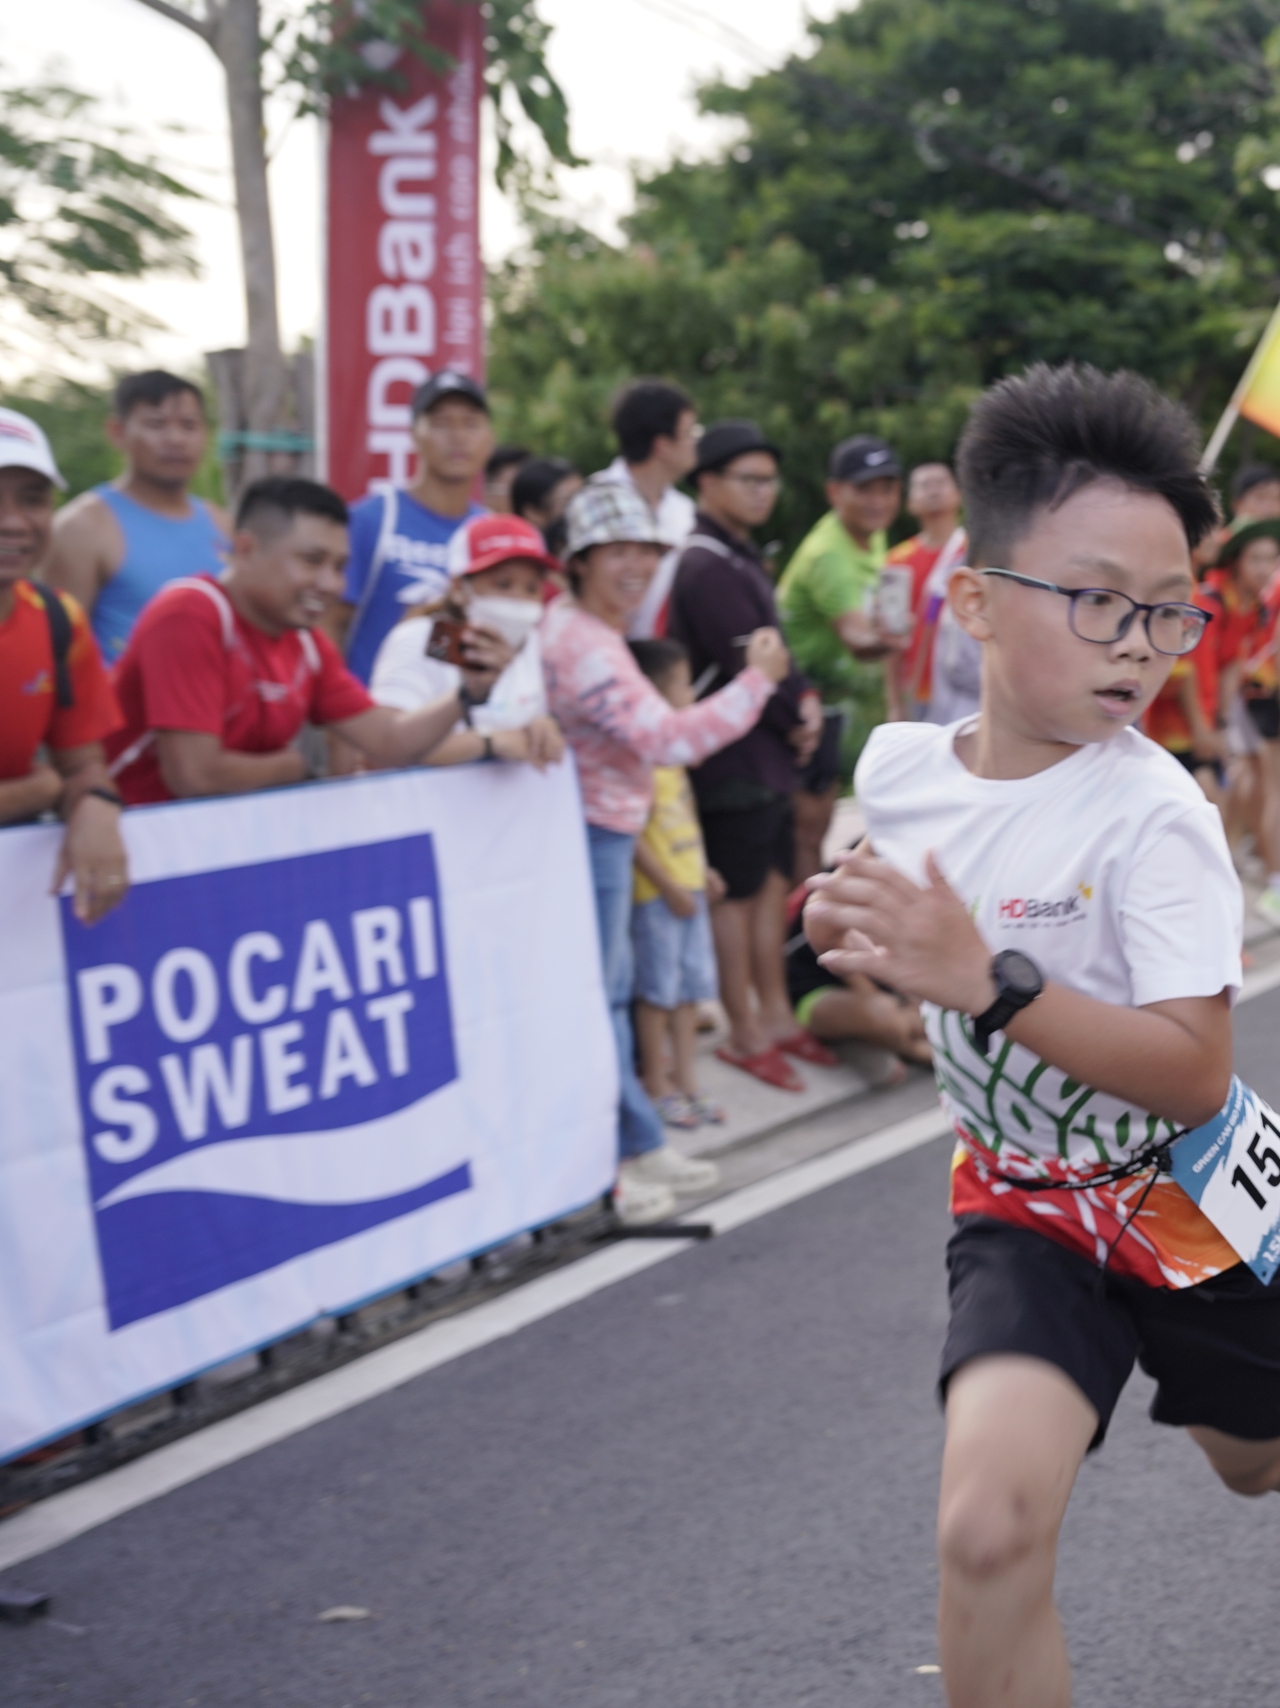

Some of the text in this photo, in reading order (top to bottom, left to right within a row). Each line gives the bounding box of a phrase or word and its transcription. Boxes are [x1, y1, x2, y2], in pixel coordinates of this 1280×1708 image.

[367, 93, 438, 497] HDBank
[77, 896, 437, 1065] POCARI
[999, 895, 1080, 919] HDBank
[90, 991, 415, 1164] SWEAT
